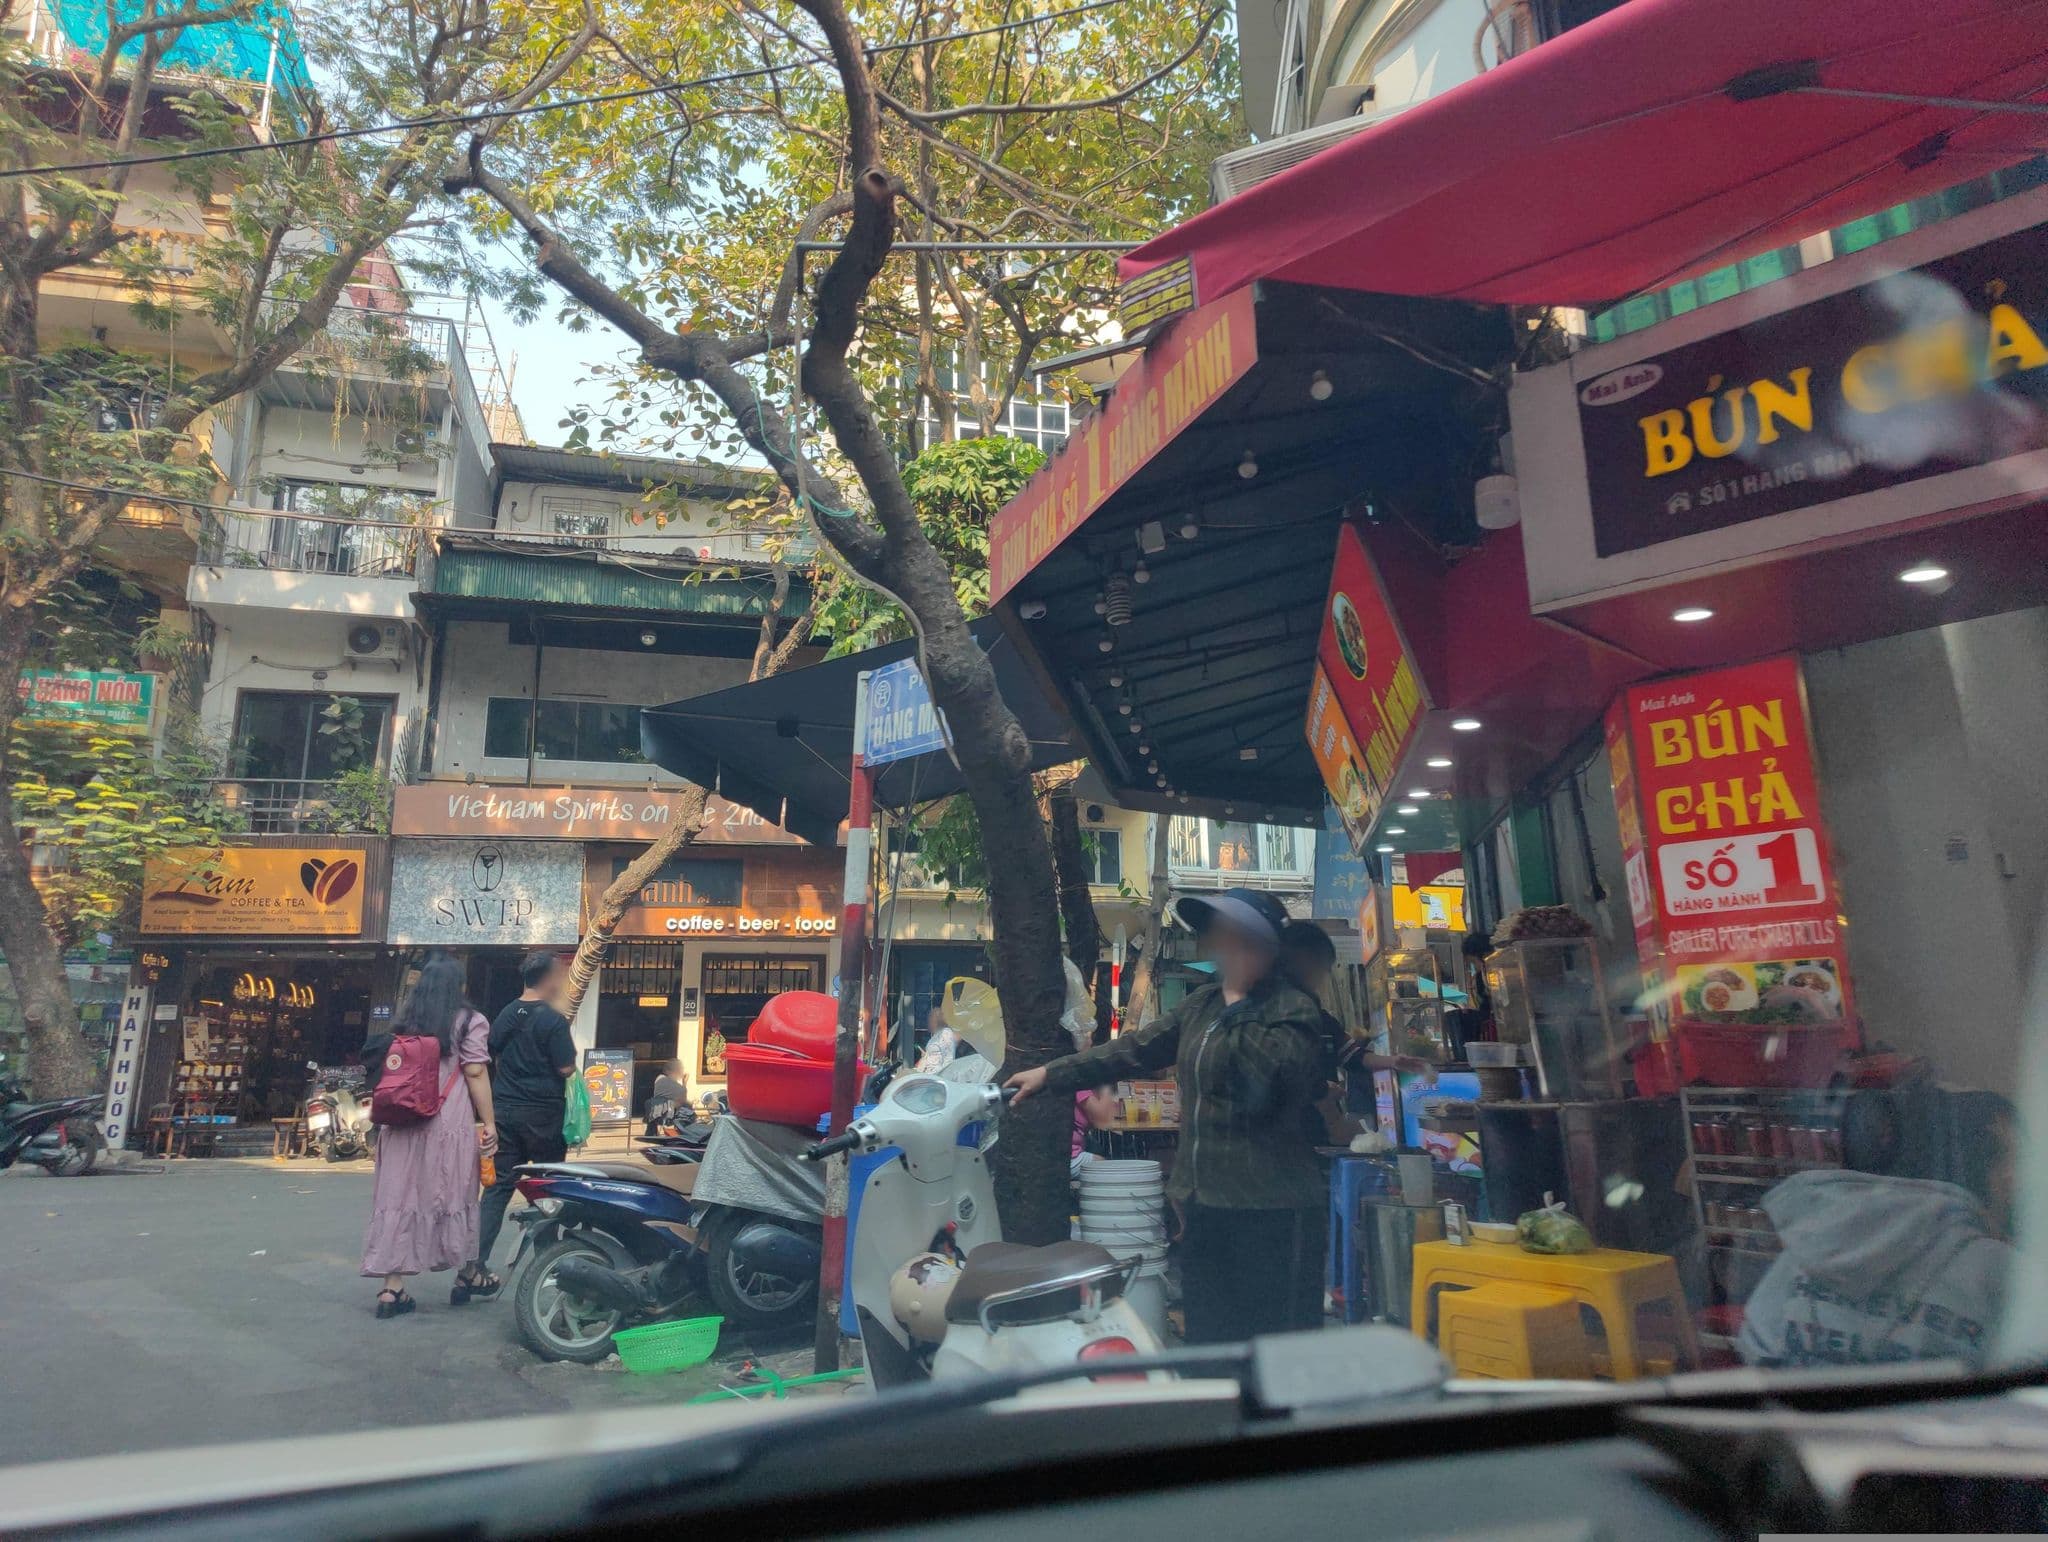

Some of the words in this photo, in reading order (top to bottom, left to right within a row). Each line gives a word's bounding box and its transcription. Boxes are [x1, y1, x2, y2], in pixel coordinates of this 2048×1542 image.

[1163, 312, 1233, 436] MÀNH
[1638, 366, 1813, 477] BÚN
[1841, 278, 2048, 414] CẢ
[1640, 695, 1665, 713] Mai
[1668, 693, 1696, 707] Anh
[873, 706, 913, 747] HÀNG
[1650, 698, 1788, 767] BÚN
[448, 793, 545, 820] Vietnam
[552, 796, 634, 832] Spirits
[640, 803, 669, 823] on
[1656, 757, 1804, 835] CHẢ
[1684, 843, 1738, 890] SỐ
[1757, 833, 1818, 903] 1
[231, 897, 270, 908] COFFEE
[286, 898, 306, 908] TEA
[1673, 894, 1713, 912] HÀNG
[1718, 892, 1761, 907] MÀNH
[666, 915, 724, 931] coffee
[739, 915, 780, 931] beer
[795, 915, 836, 931] food
[685, 1001, 696, 1009] 20
